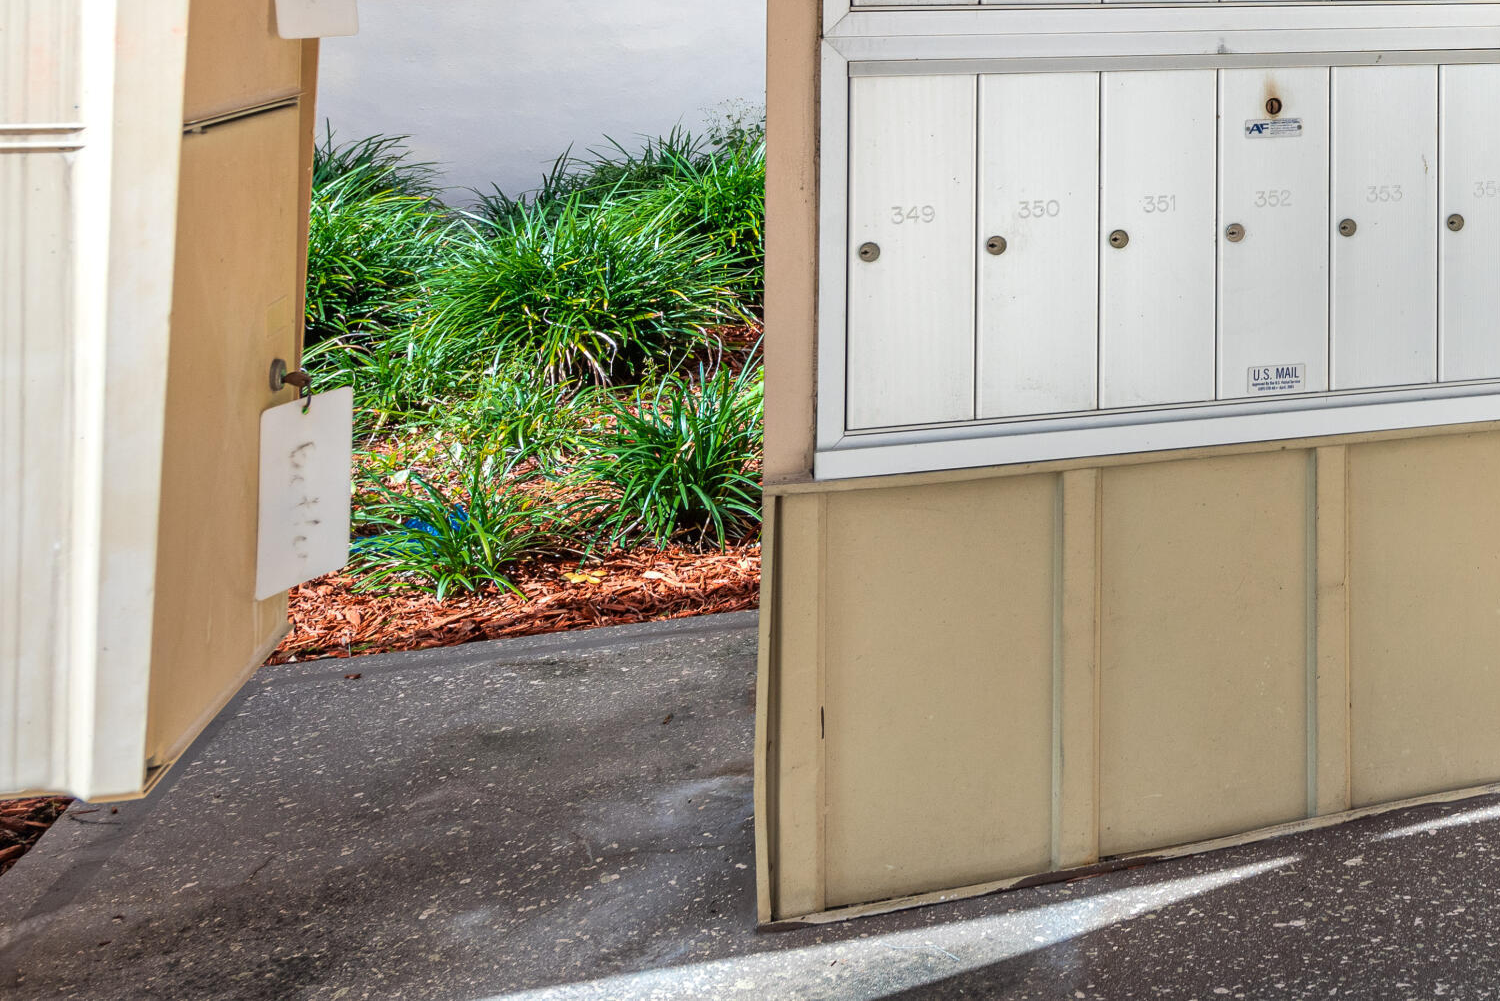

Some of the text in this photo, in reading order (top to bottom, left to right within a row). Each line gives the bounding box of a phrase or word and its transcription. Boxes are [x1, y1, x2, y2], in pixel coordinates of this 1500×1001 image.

[1143, 194, 1176, 213] 351
[1254, 189, 1292, 208] 352
[1366, 185, 1404, 203] 353
[891, 204, 936, 224] 349
[1018, 199, 1060, 219] 350
[1253, 366, 1300, 381] U.S. MAIL
